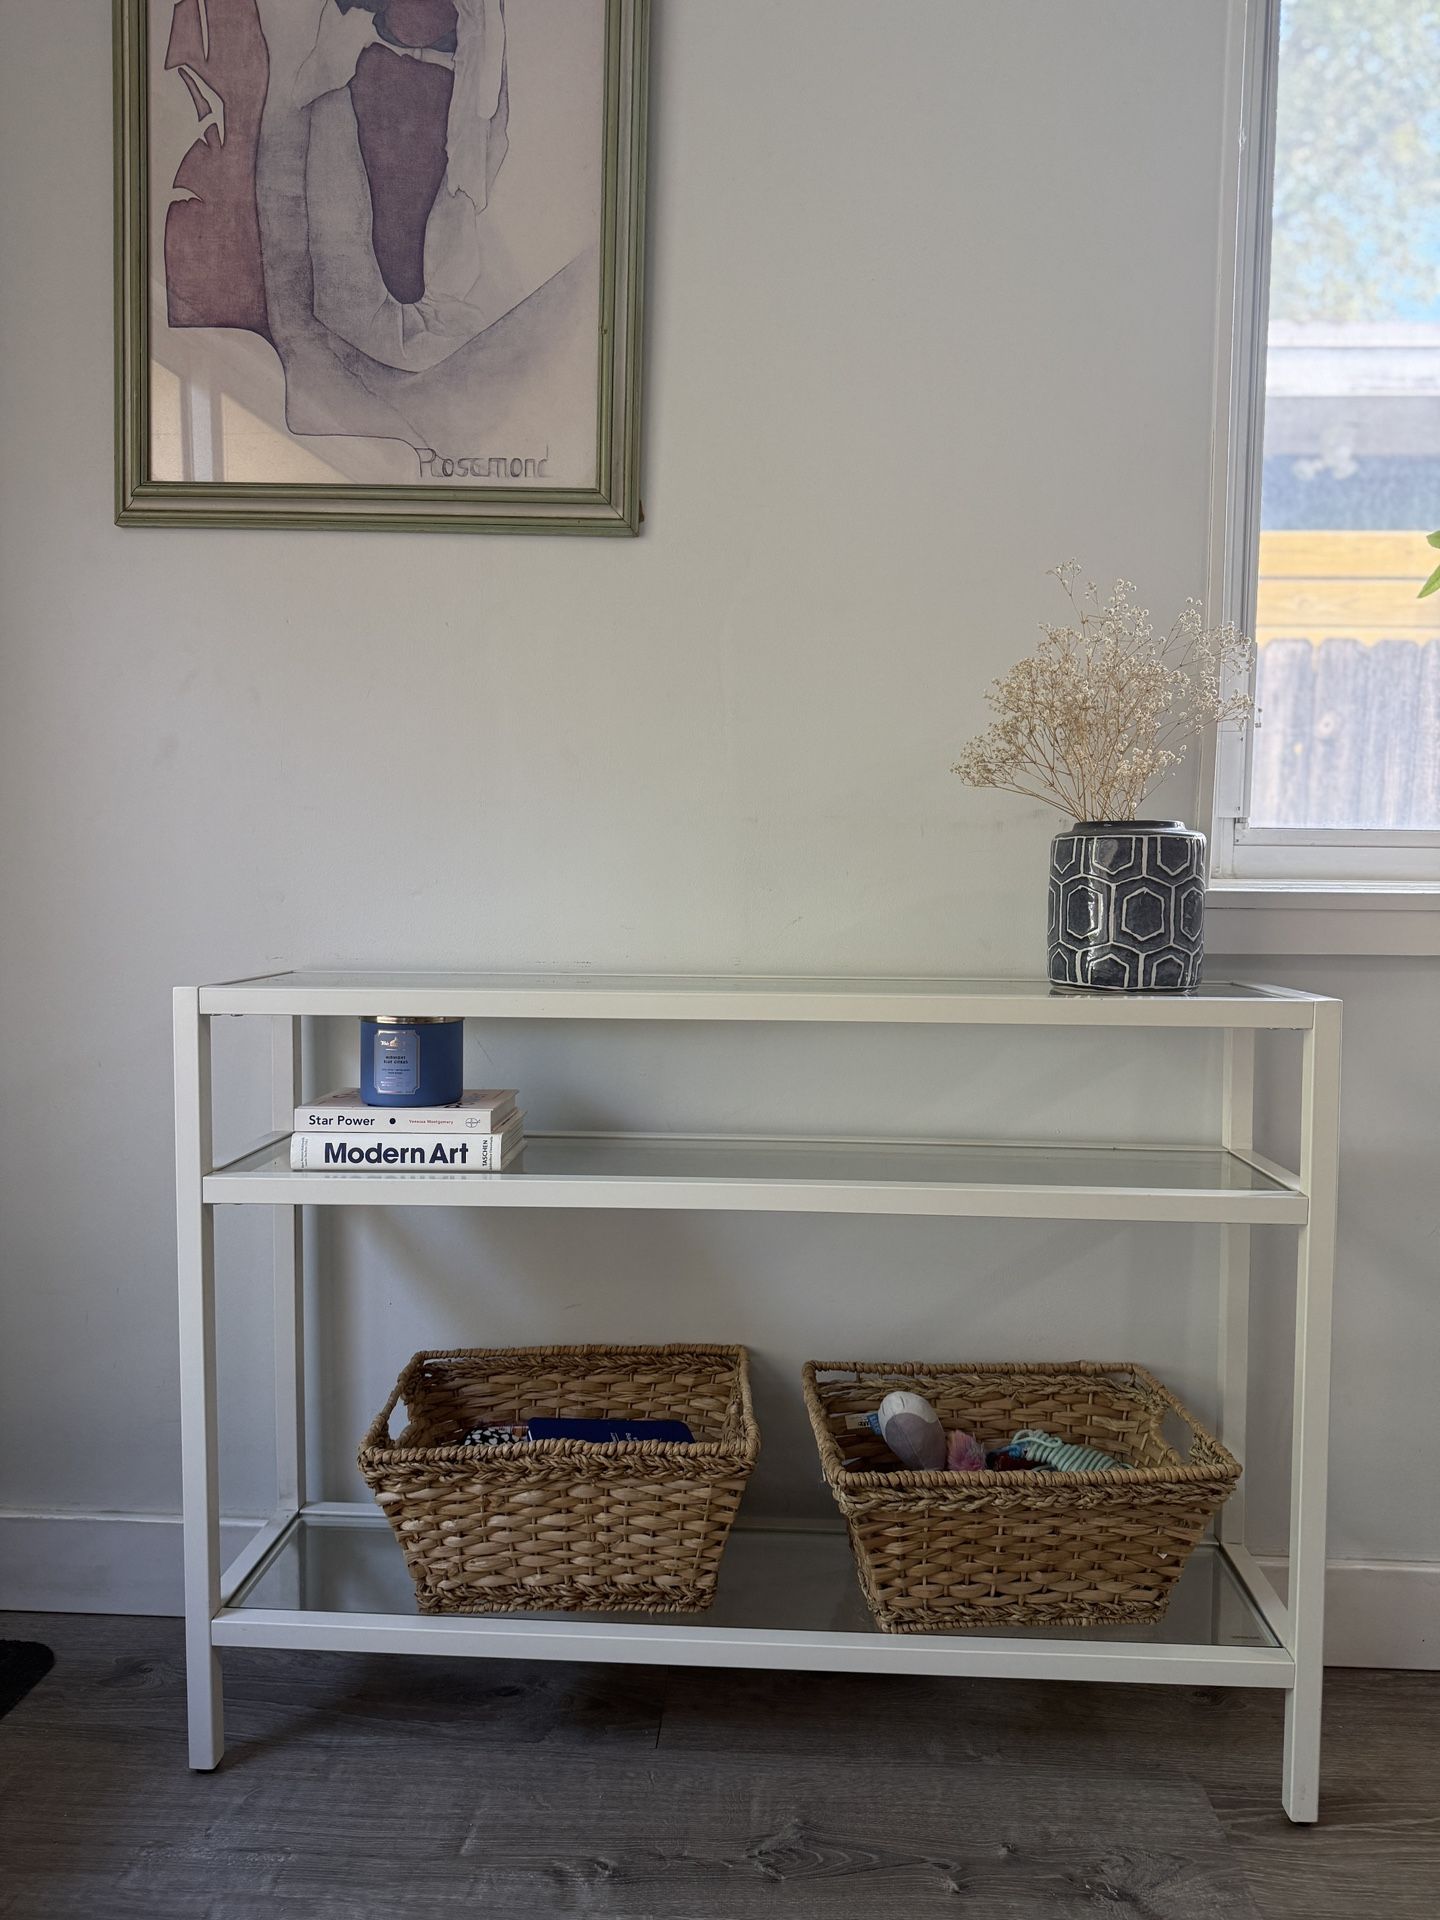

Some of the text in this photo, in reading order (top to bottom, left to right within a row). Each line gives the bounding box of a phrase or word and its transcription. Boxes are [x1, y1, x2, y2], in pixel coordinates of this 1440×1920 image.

[309, 1115, 375, 1126] Star Power
[324, 1143, 427, 1164] Modern
[429, 1143, 469, 1164] Art
